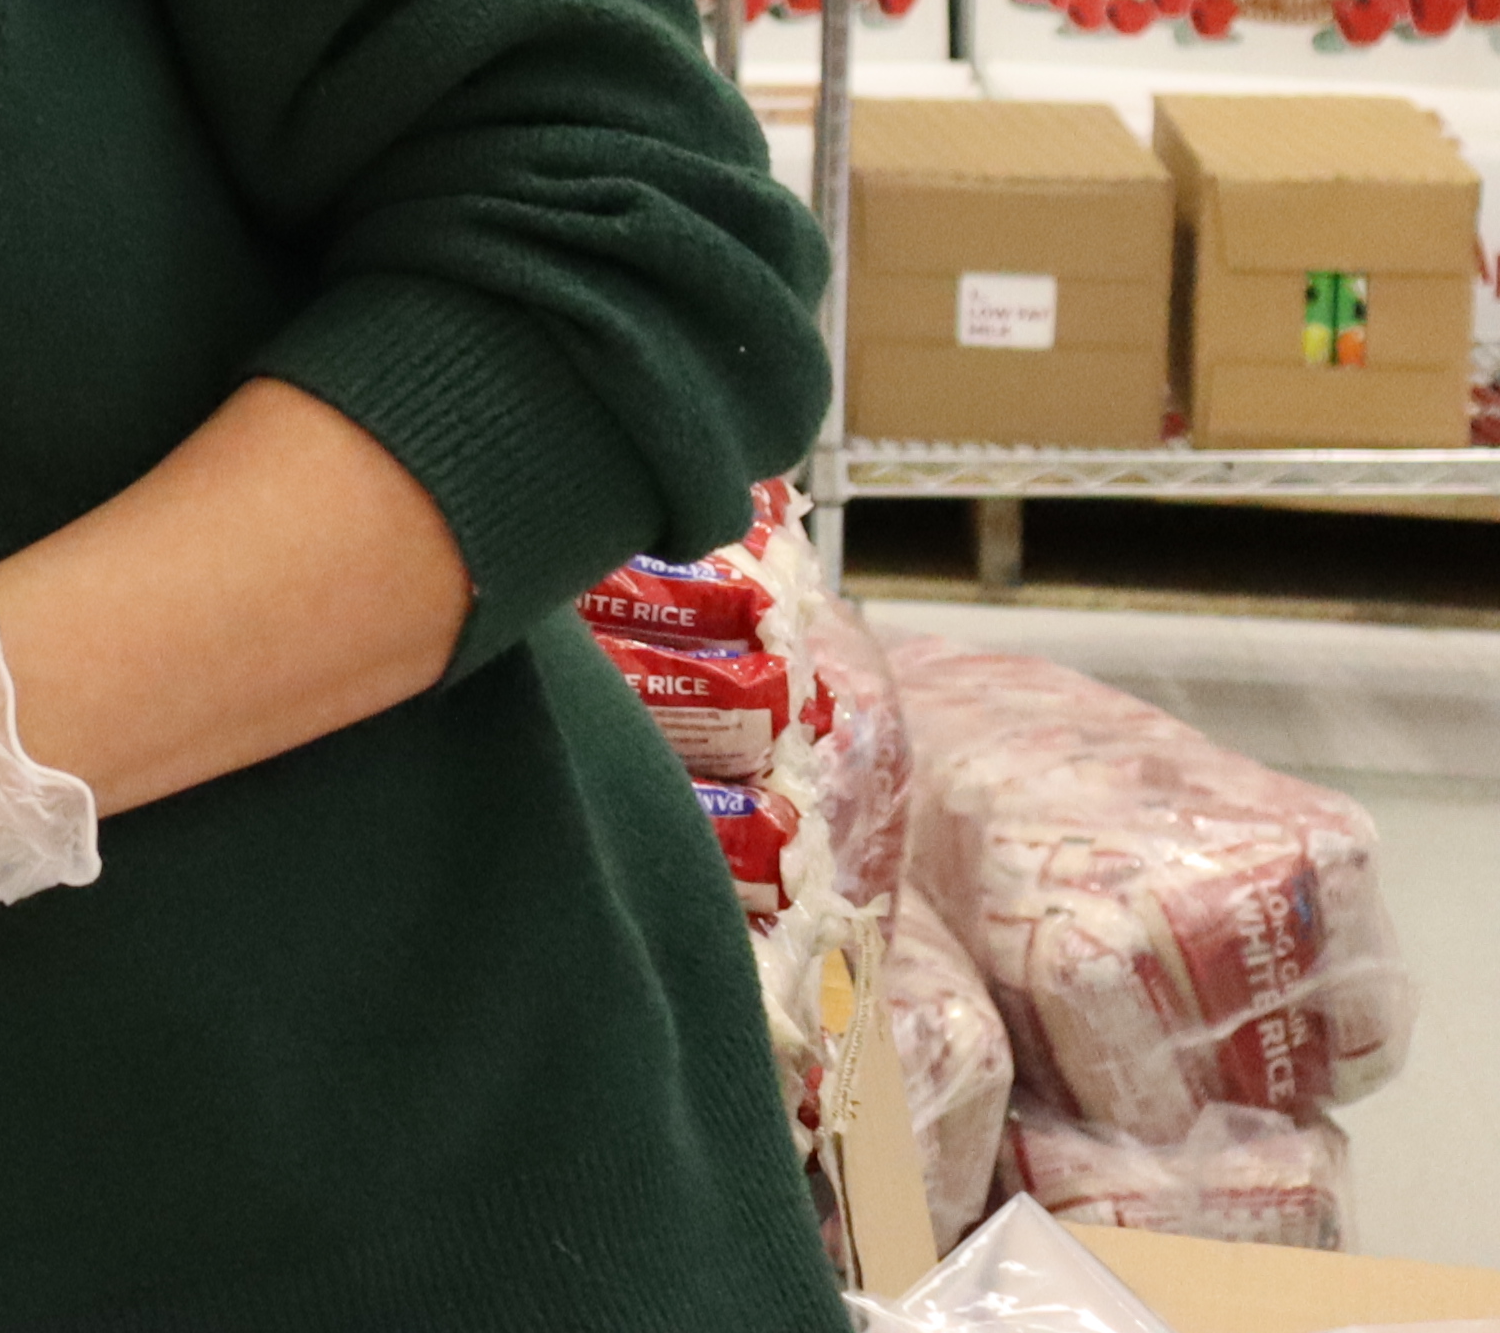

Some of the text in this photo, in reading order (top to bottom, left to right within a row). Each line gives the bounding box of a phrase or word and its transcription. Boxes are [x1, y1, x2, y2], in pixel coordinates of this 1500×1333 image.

[577, 592, 697, 627] ITE RICE
[646, 674, 710, 697] RICE
[1256, 1019, 1297, 1106] RICE
